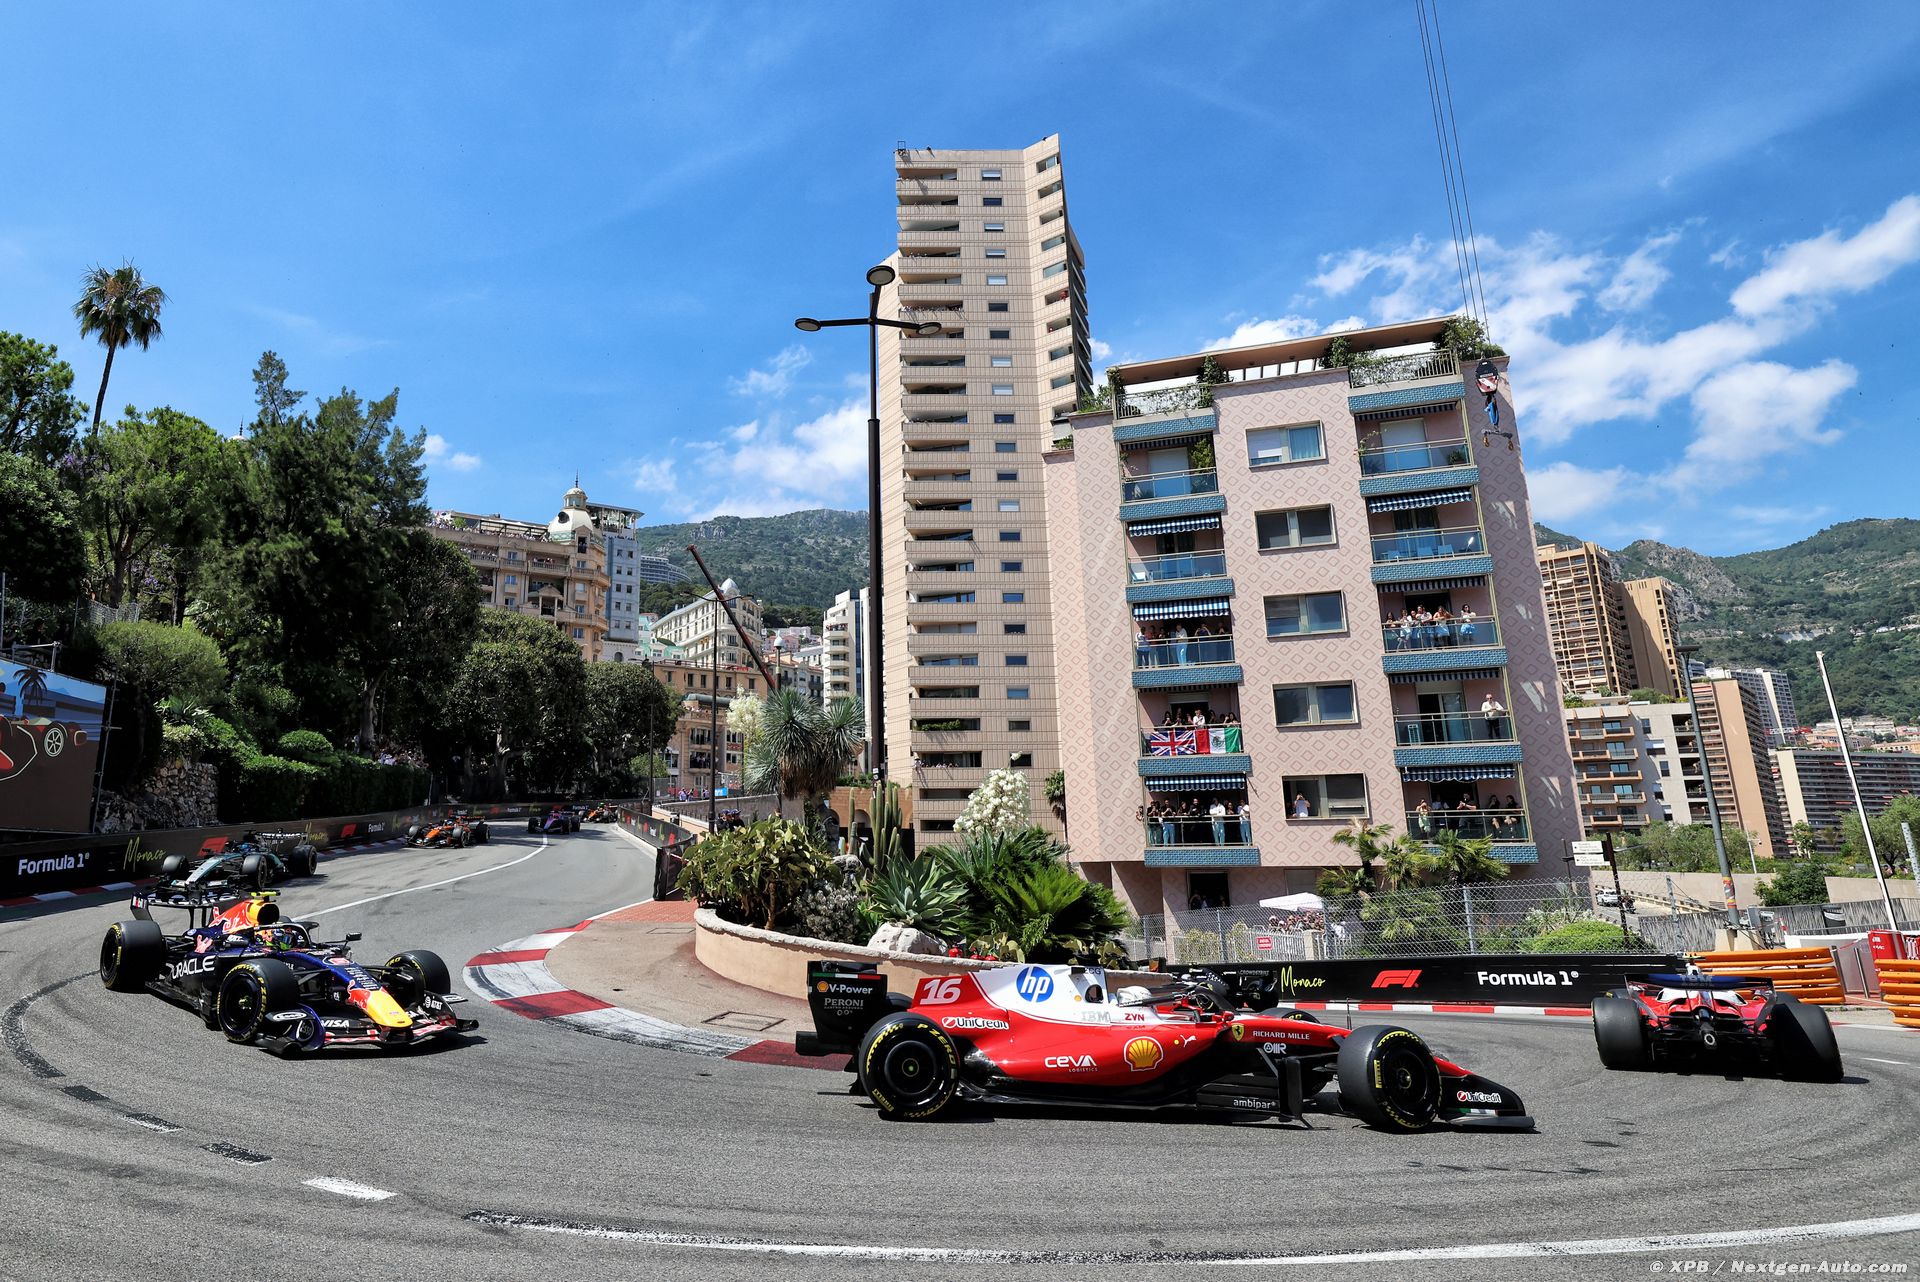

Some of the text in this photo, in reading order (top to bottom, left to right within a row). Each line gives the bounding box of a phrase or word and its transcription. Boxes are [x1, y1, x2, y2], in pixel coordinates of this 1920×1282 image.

[123, 836, 167, 872] Monaco
[18, 854, 75, 875] Formula
[1020, 965, 1050, 1003] hp
[1280, 965, 1326, 997] Monaco
[1371, 969, 1422, 988] F1
[1478, 971, 1556, 985] Formula
[829, 983, 873, 995] V-Power
[920, 978, 962, 1005] 16
[824, 997, 864, 1007] PERONI
[321, 1019, 350, 1028] VISA
[956, 1017, 1008, 1030] UniCredit
[1082, 1011, 1111, 1023] IBM
[1125, 1013, 1146, 1022] ZYN
[1252, 1030, 1310, 1040] RICHARD MILLE
[1233, 1099, 1272, 1109] ambipar
